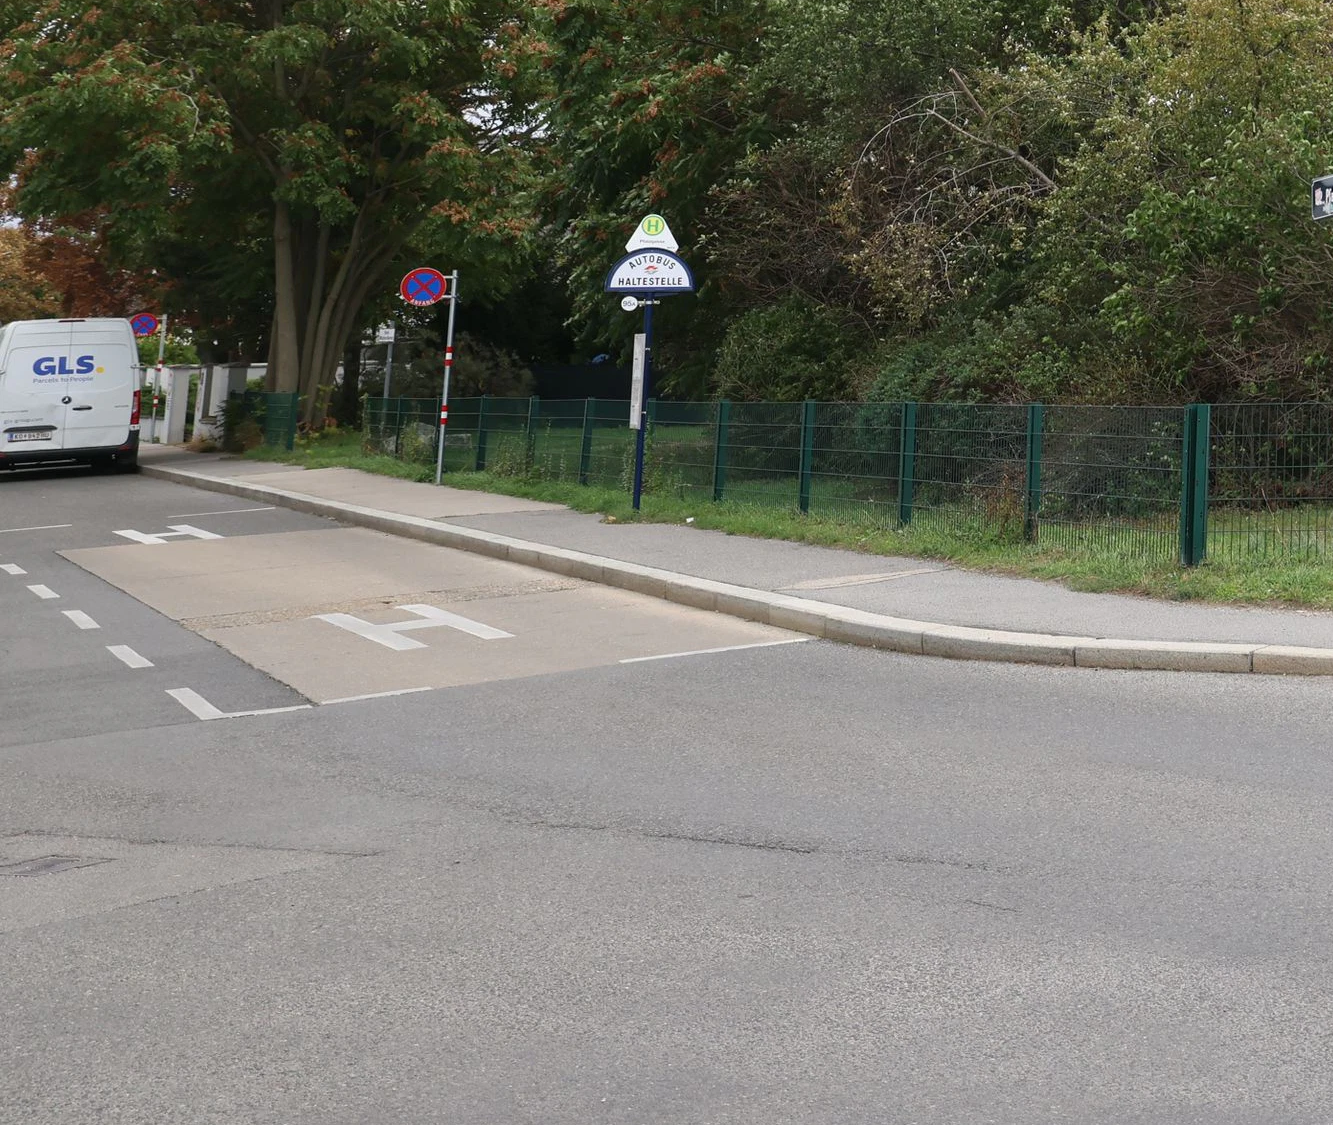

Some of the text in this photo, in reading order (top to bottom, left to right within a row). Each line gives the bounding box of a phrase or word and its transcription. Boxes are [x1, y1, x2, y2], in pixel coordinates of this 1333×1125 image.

[647, 220, 659, 232] H
[629, 255, 676, 270] AUTOBUS
[618, 277, 683, 286] HALTESTELLE
